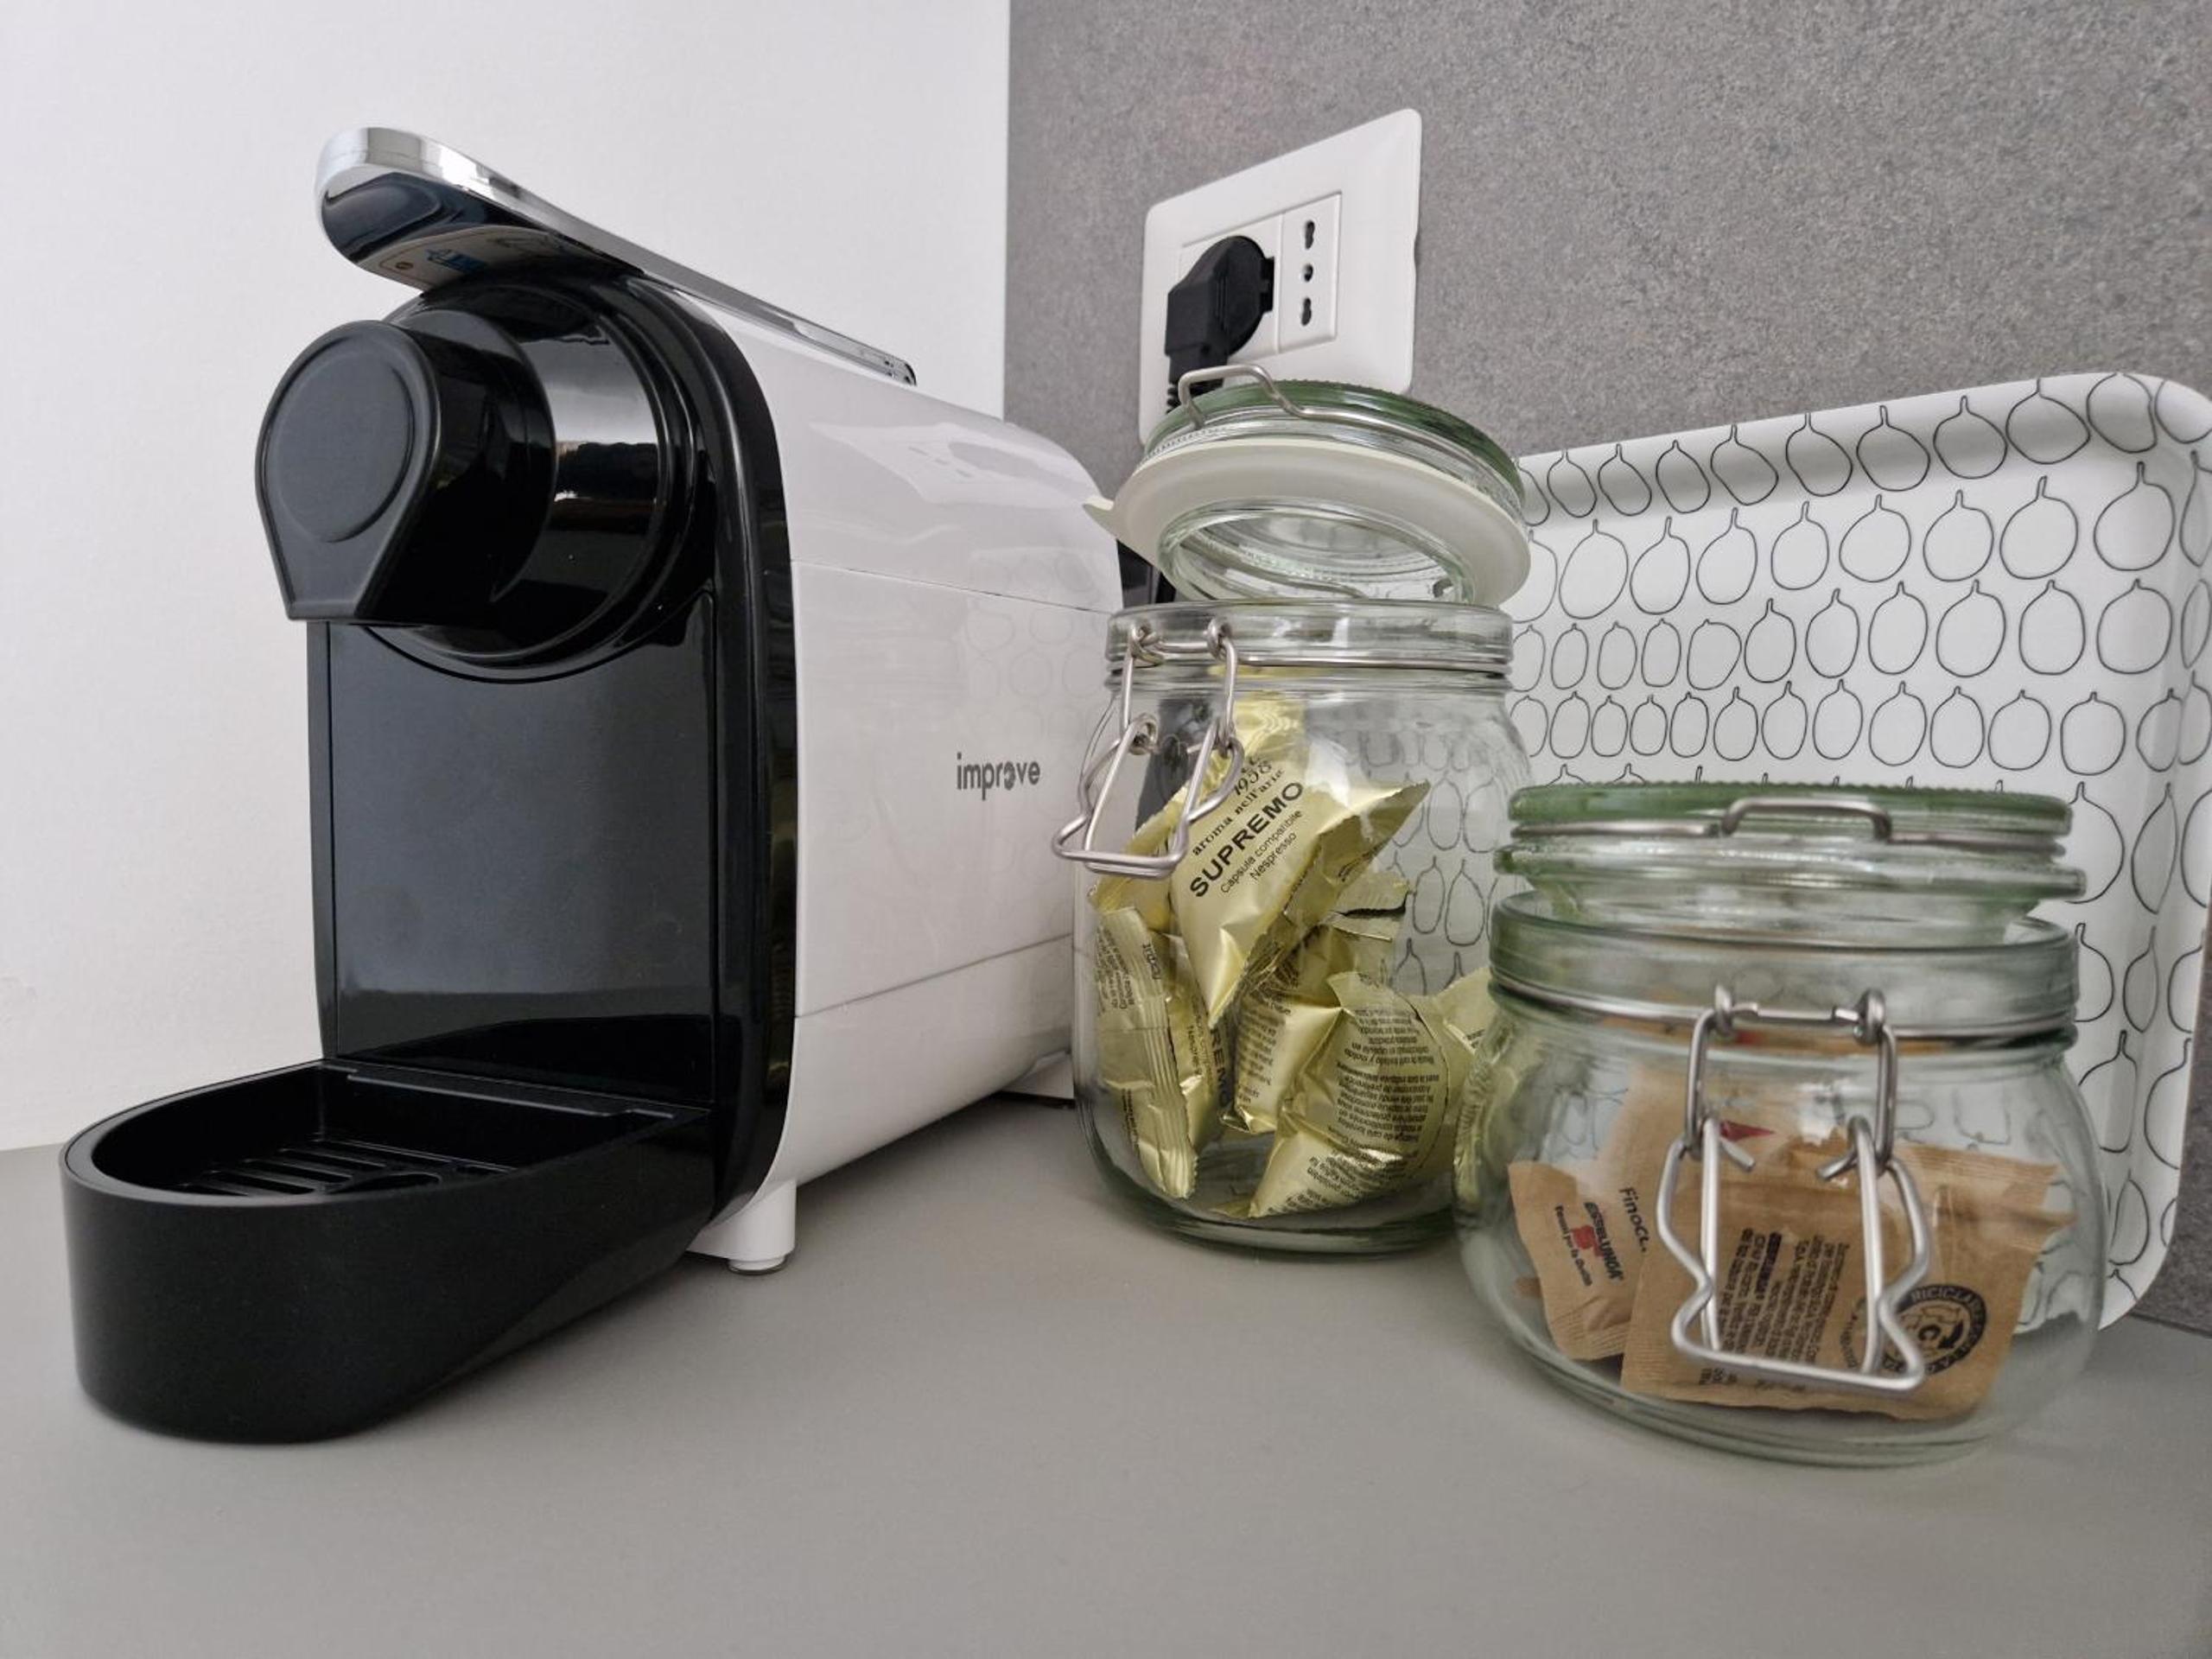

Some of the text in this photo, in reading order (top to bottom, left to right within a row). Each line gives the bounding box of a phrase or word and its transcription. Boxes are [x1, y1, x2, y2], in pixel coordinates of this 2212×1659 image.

[957, 752, 1040, 801] improve
[1190, 781, 1304, 899] SUPREMO
[1192, 815, 1233, 856] aroma
[1220, 810, 1304, 893] Capsula compatibile
[1249, 831, 1297, 881] Nespresso
